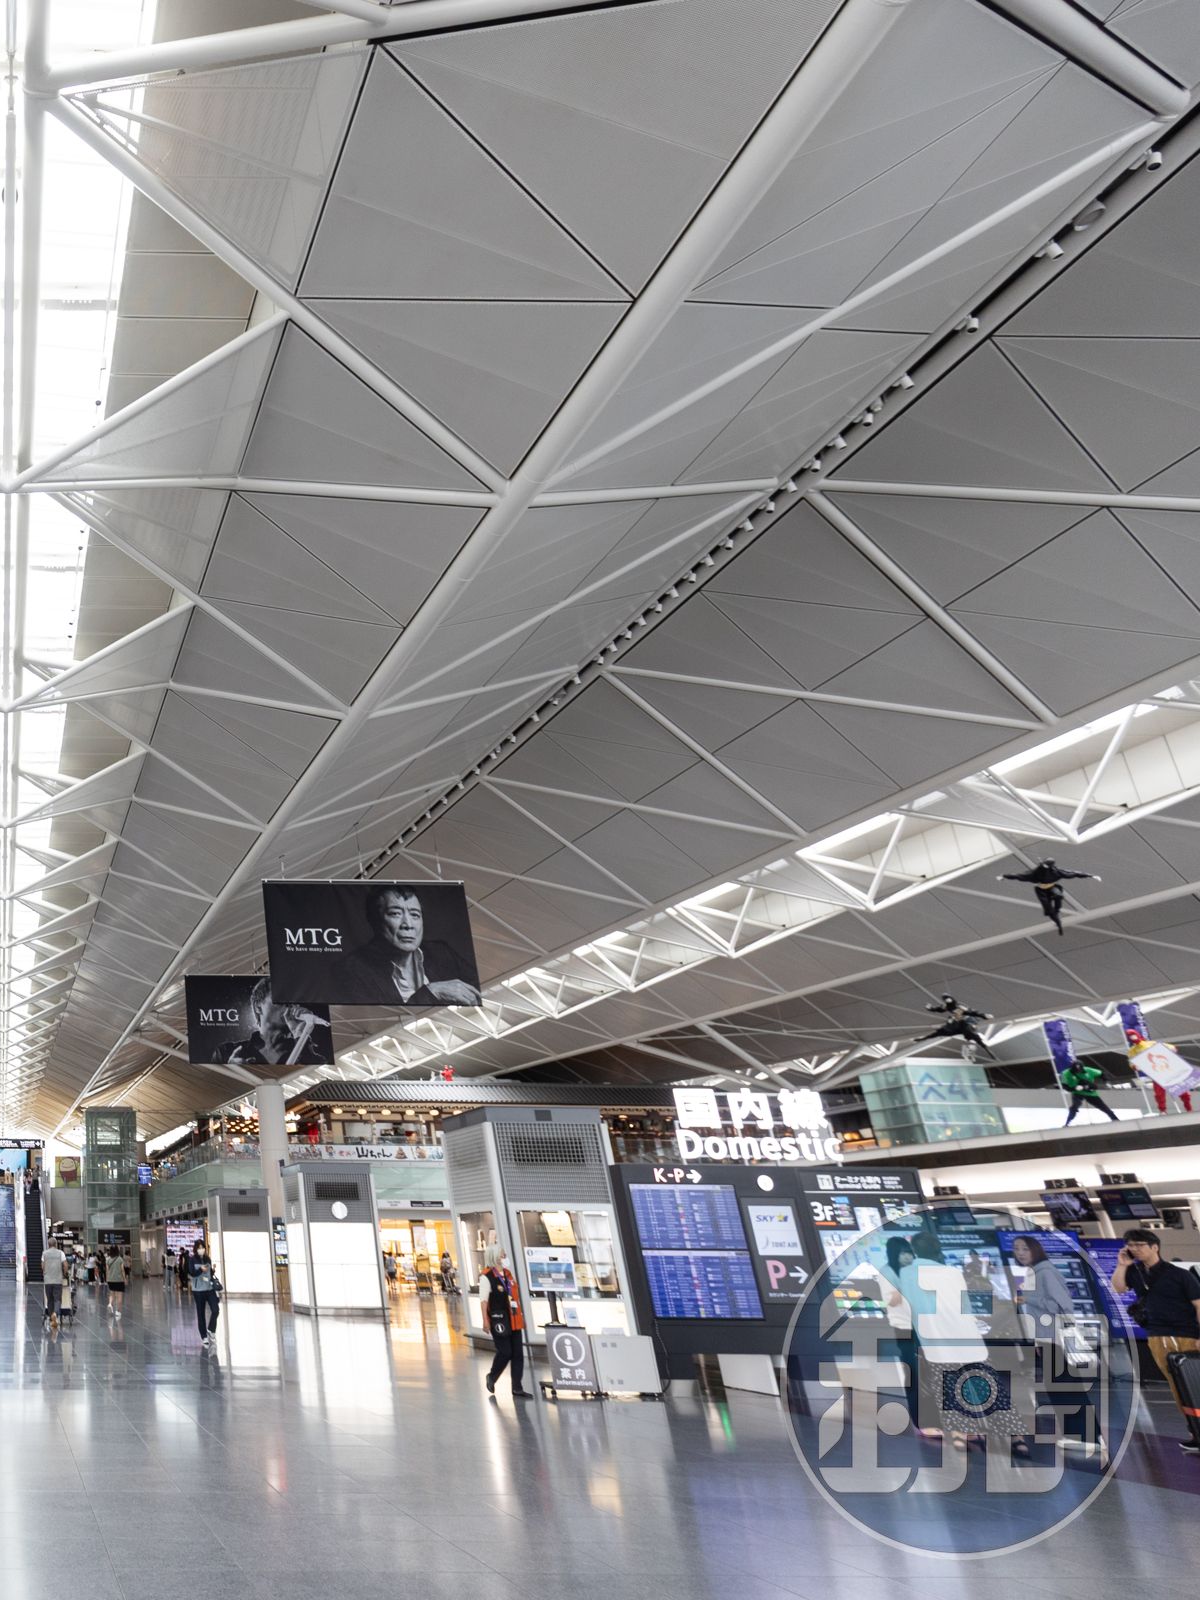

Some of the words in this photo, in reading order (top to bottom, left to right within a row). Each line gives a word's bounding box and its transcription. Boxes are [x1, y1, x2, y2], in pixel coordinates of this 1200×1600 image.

[284, 927, 343, 946] MTG
[199, 1008, 240, 1022] MTG
[672, 1088, 828, 1130] 国内線
[676, 1129, 844, 1161] Domestic
[653, 1167, 685, 1183] K-P
[810, 1201, 834, 1221] 3F
[765, 1260, 788, 1290] P
[556, 1379, 593, 1387] Information
[560, 1368, 586, 1379] 案内
